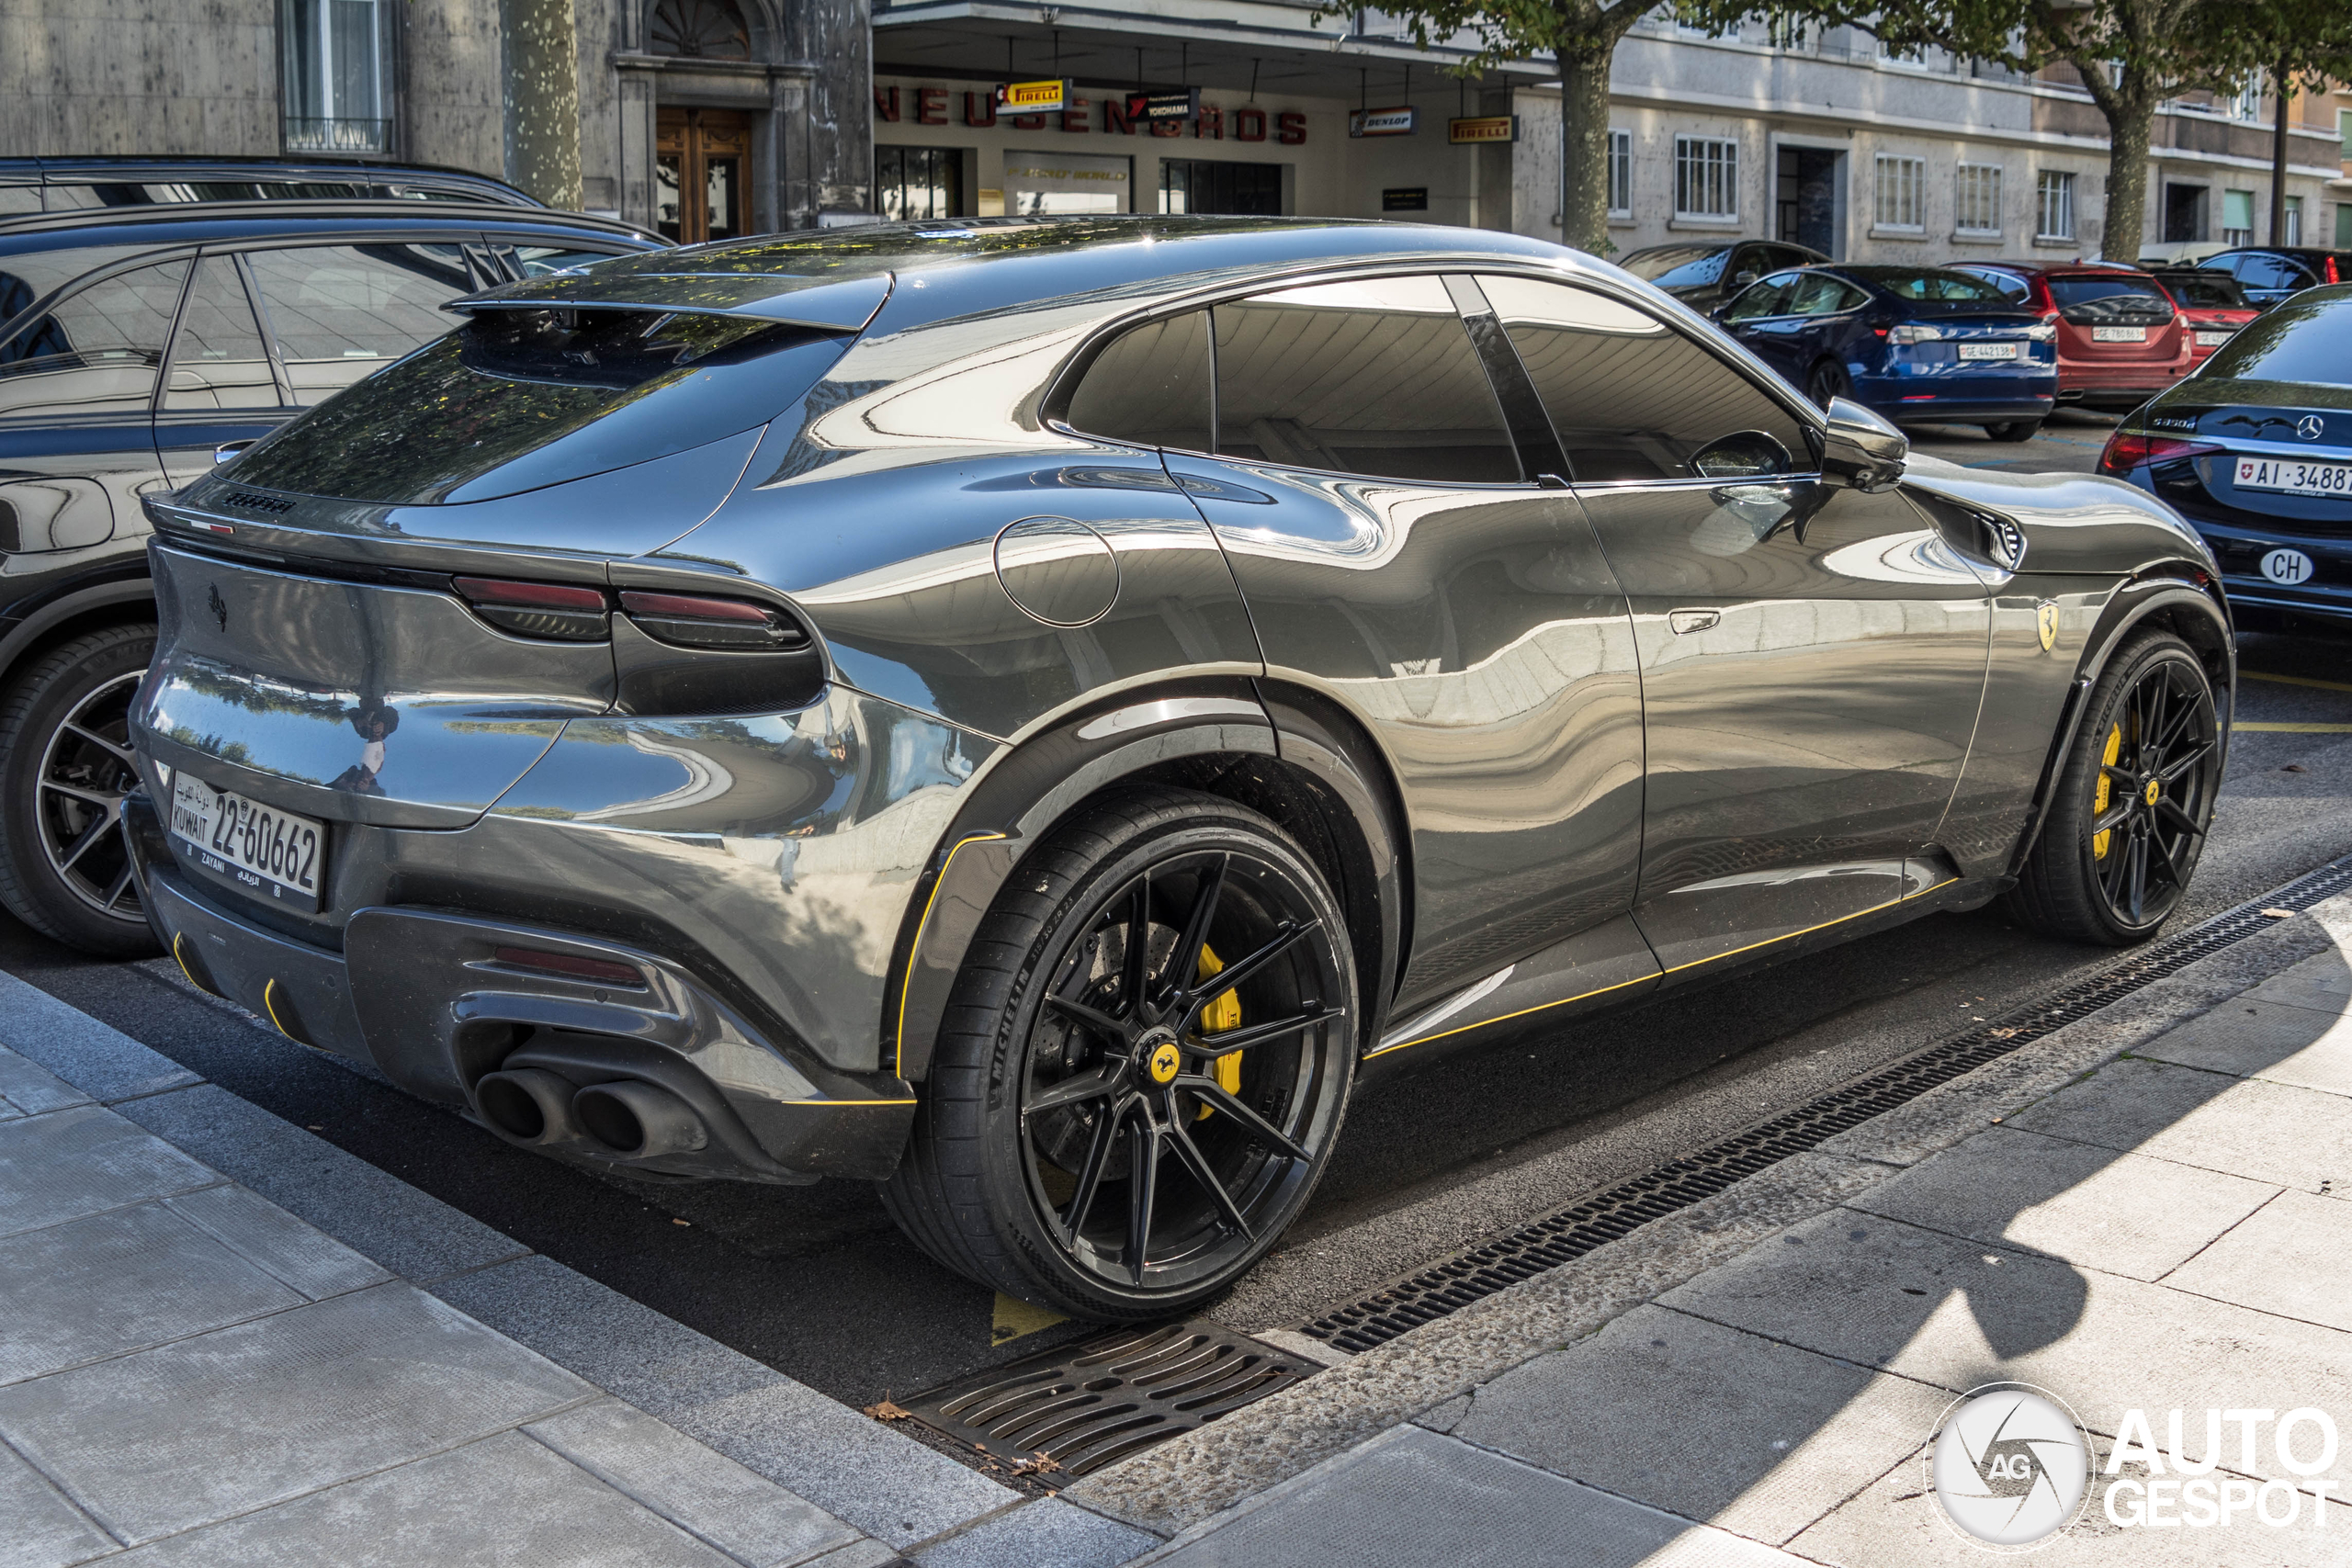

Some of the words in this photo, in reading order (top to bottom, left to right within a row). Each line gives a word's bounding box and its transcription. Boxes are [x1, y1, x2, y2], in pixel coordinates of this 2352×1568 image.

[1015, 85, 1059, 102] PIRELLI
[1148, 104, 1189, 118] YOKOHAMA
[1367, 116, 1408, 127] DUNLOP
[1453, 120, 1509, 139] PIRELLI
[2272, 553, 2301, 581] CH
[2098, 674, 2127, 732] MICHELIN
[173, 803, 208, 842] KUWAIT
[201, 852, 225, 874] ZAYANI
[237, 871, 260, 886] الزياني
[992, 968, 1031, 1081] MICHELIN
[1030, 925, 1053, 962] 315/30
[1052, 909, 1064, 925] ZR
[1063, 896, 1074, 910] 23
